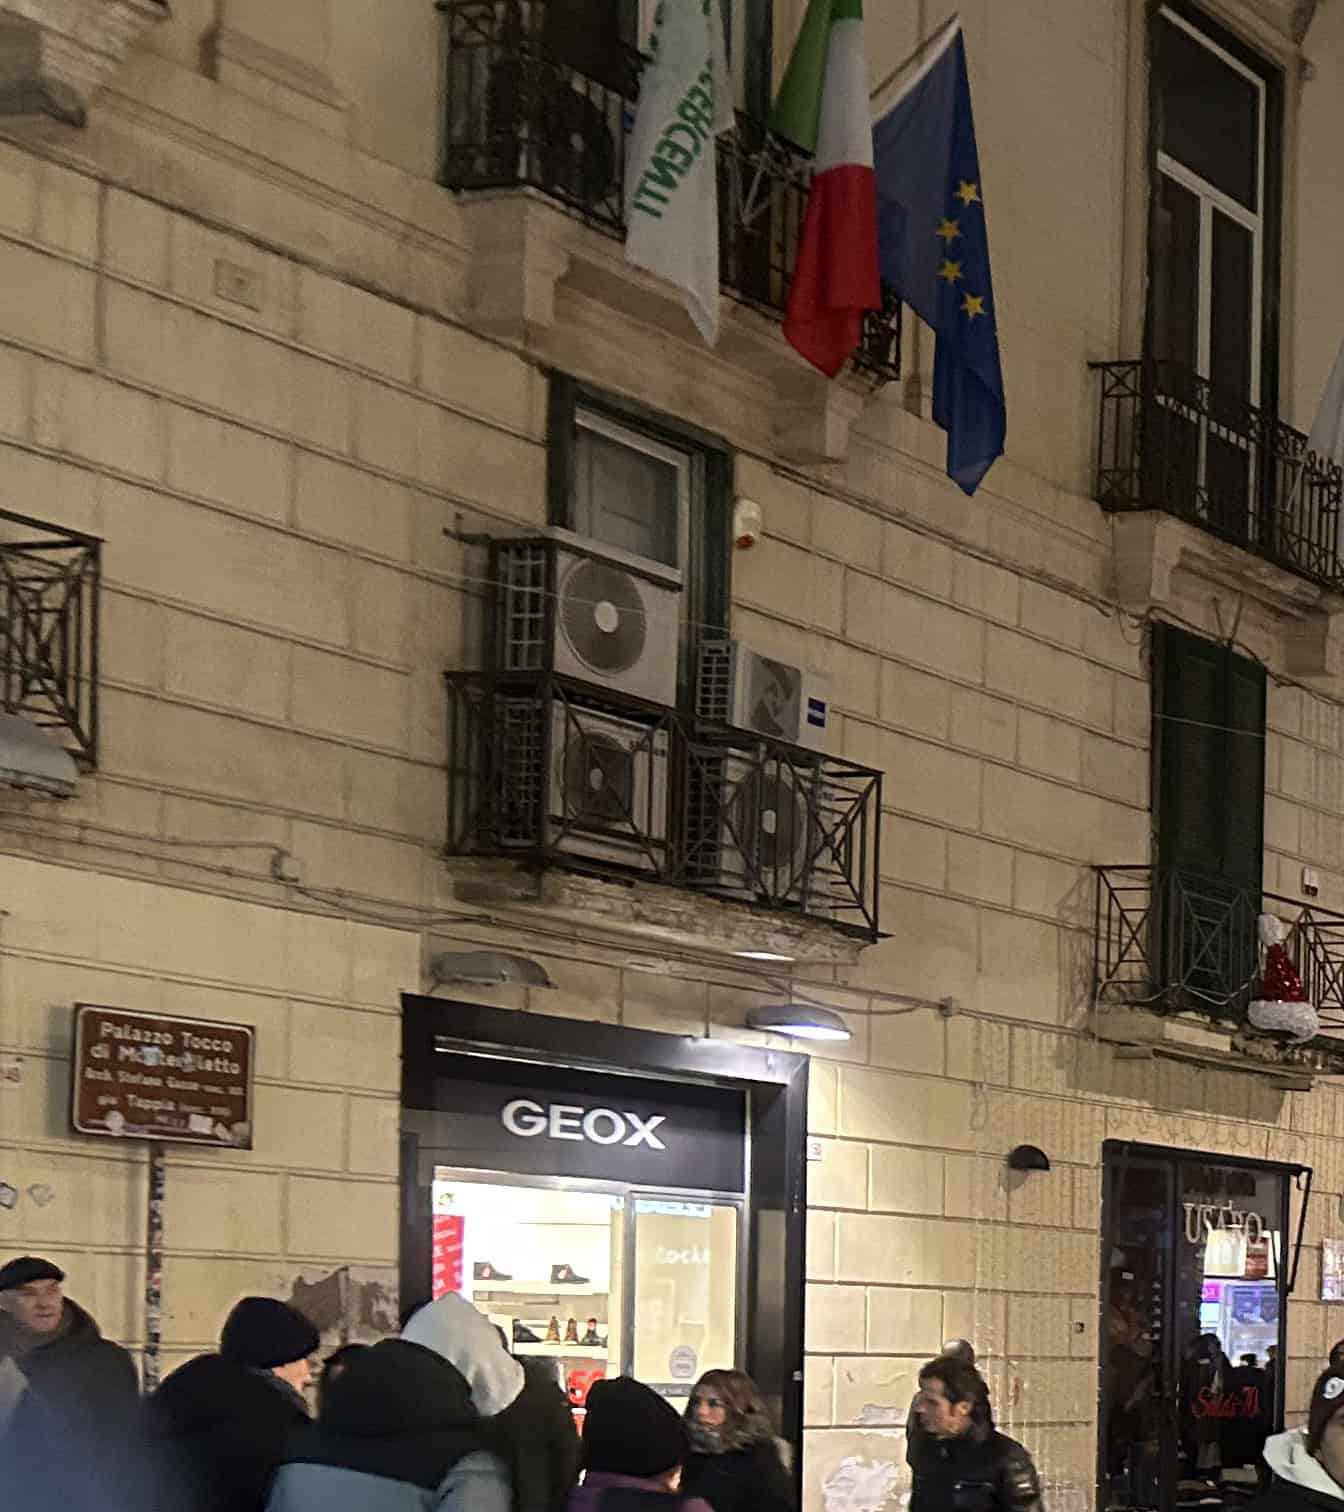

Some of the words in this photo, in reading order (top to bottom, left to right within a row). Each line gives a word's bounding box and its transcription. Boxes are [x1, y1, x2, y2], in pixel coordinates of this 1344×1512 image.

[101, 1021, 173, 1045] Palazzo
[181, 1032, 233, 1053] Tocco
[502, 1100, 667, 1150] GEOX
